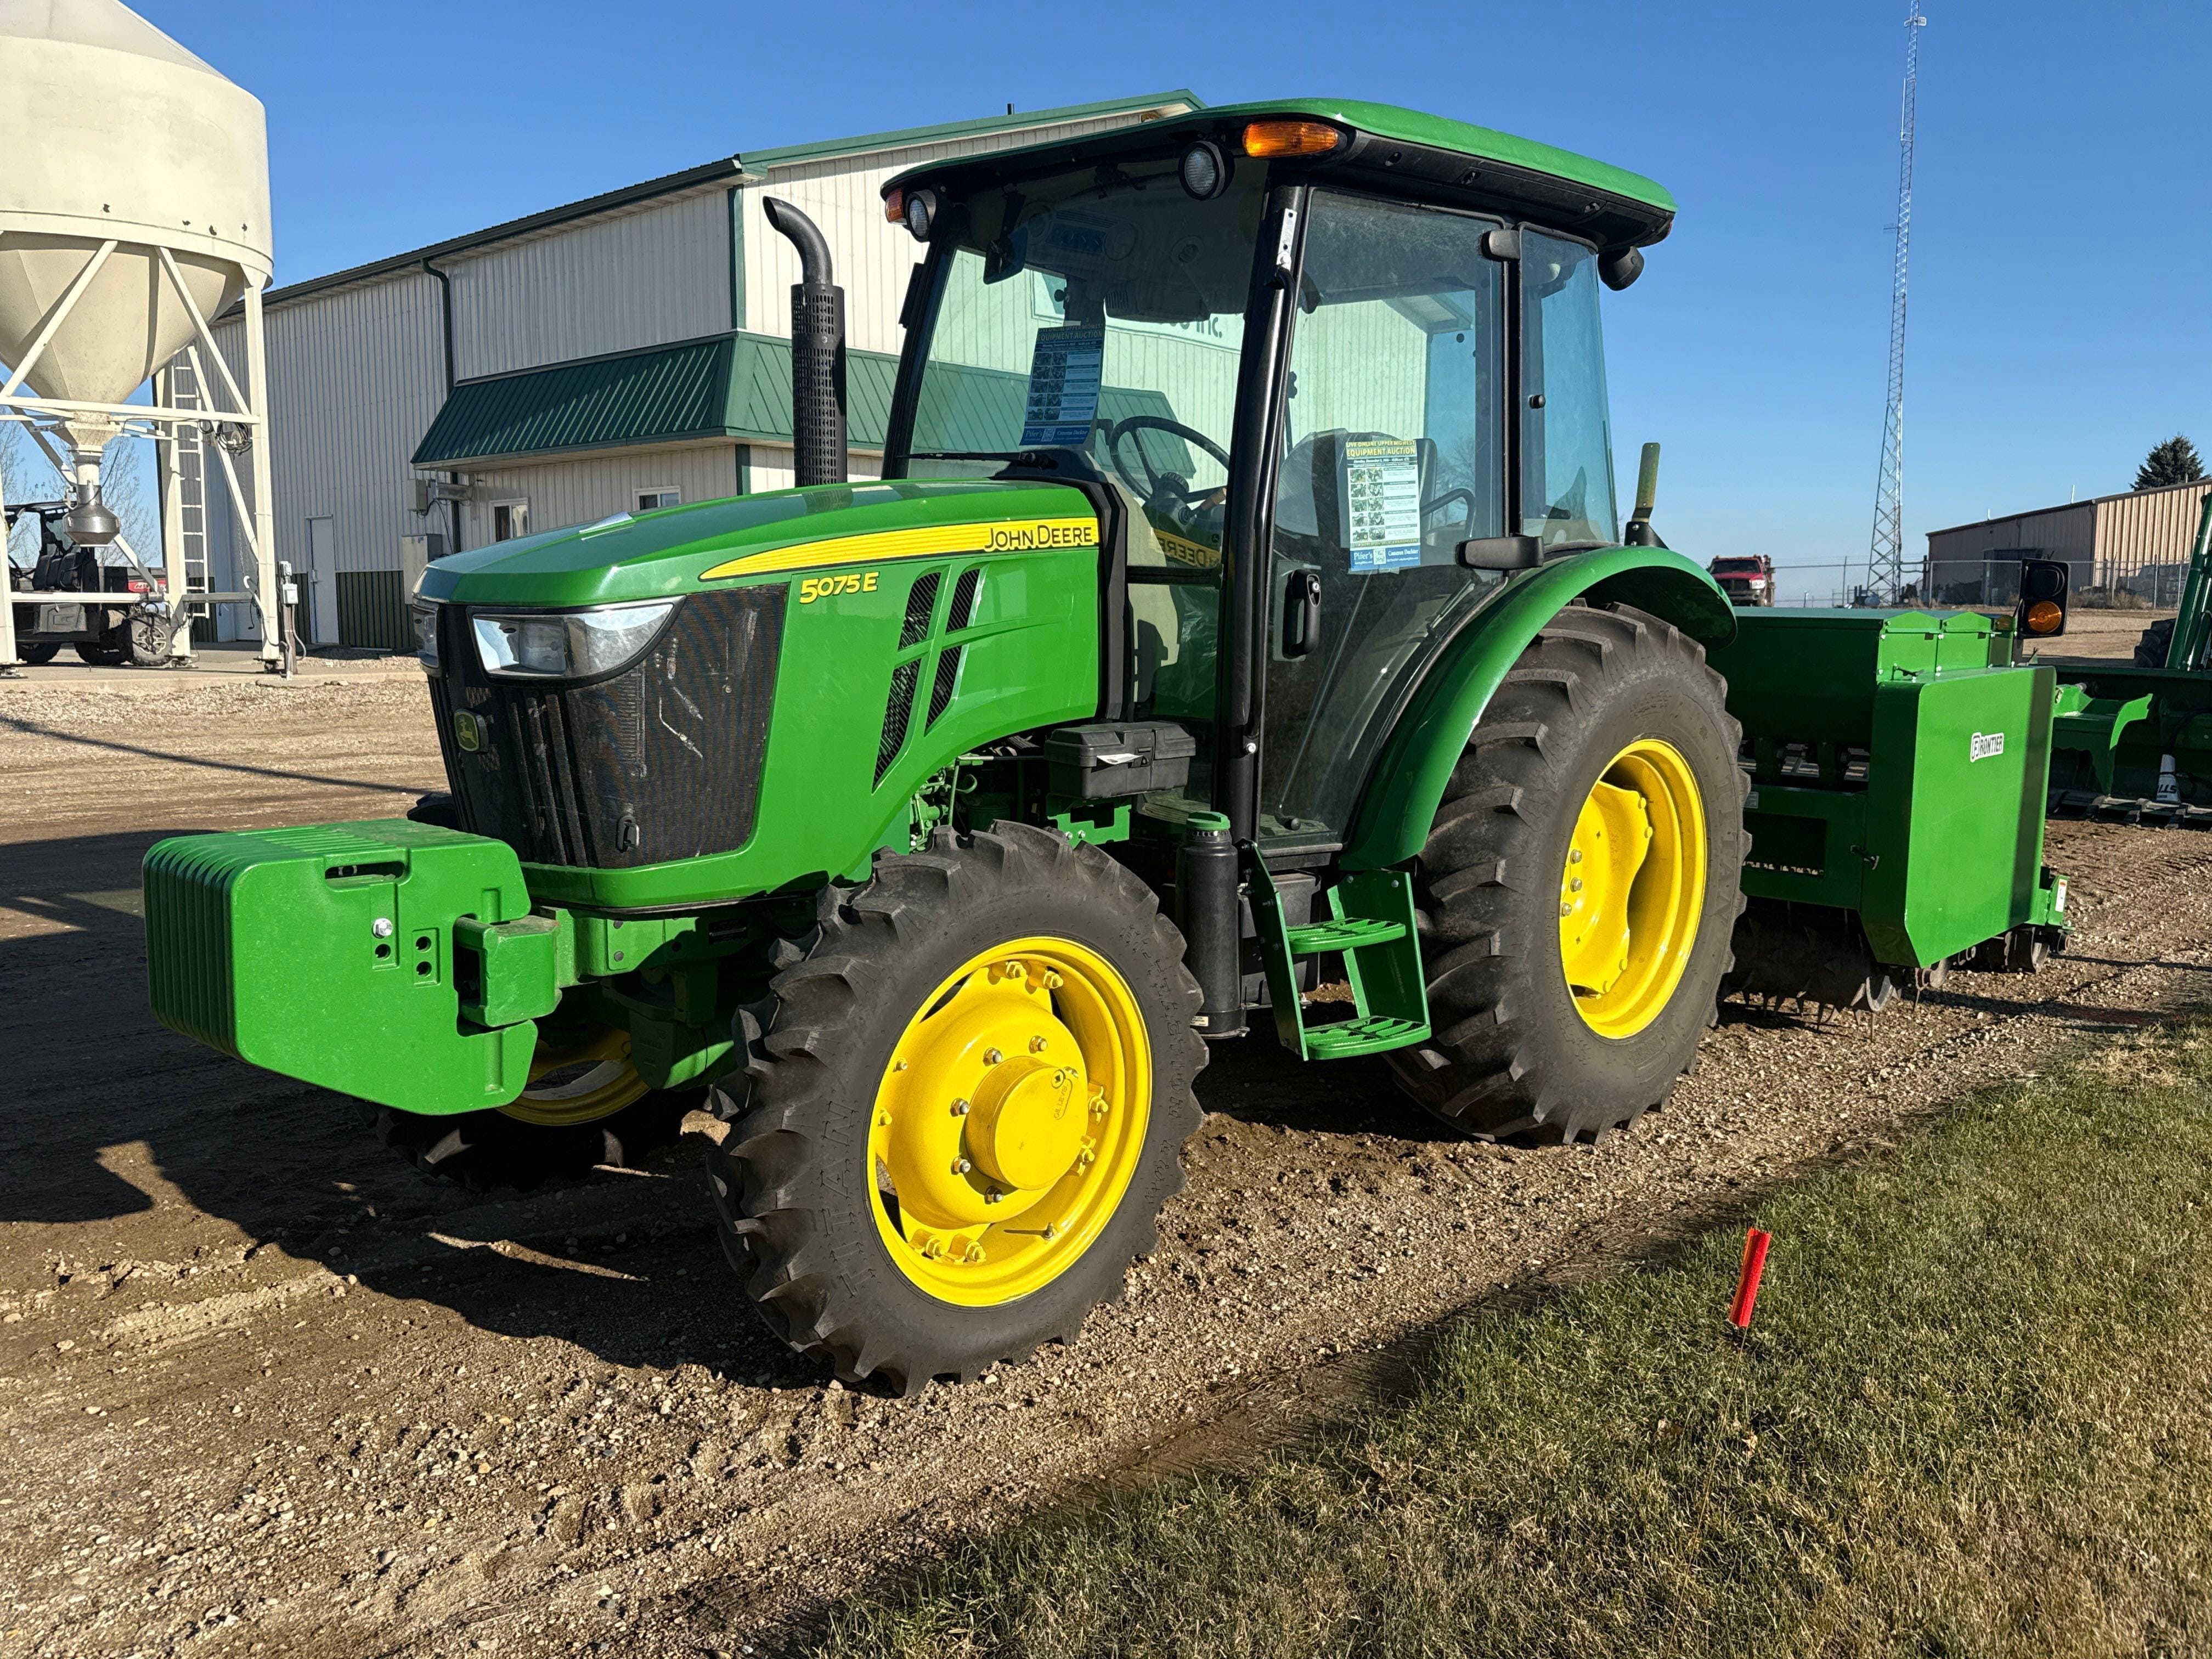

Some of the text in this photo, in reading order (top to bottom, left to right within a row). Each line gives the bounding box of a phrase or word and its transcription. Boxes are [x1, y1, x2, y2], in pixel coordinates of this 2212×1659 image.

[1075, 331, 1102, 339] AUCTION
[1347, 447, 1415, 457] EQUIPMENT AUCTION
[984, 524, 1092, 549] JOHN DEERE
[1353, 551, 1373, 560] Pifer's
[799, 571, 880, 605] 5075E
[1971, 735, 2003, 760] FRONTIER
[822, 1101, 877, 1298] TITAN
